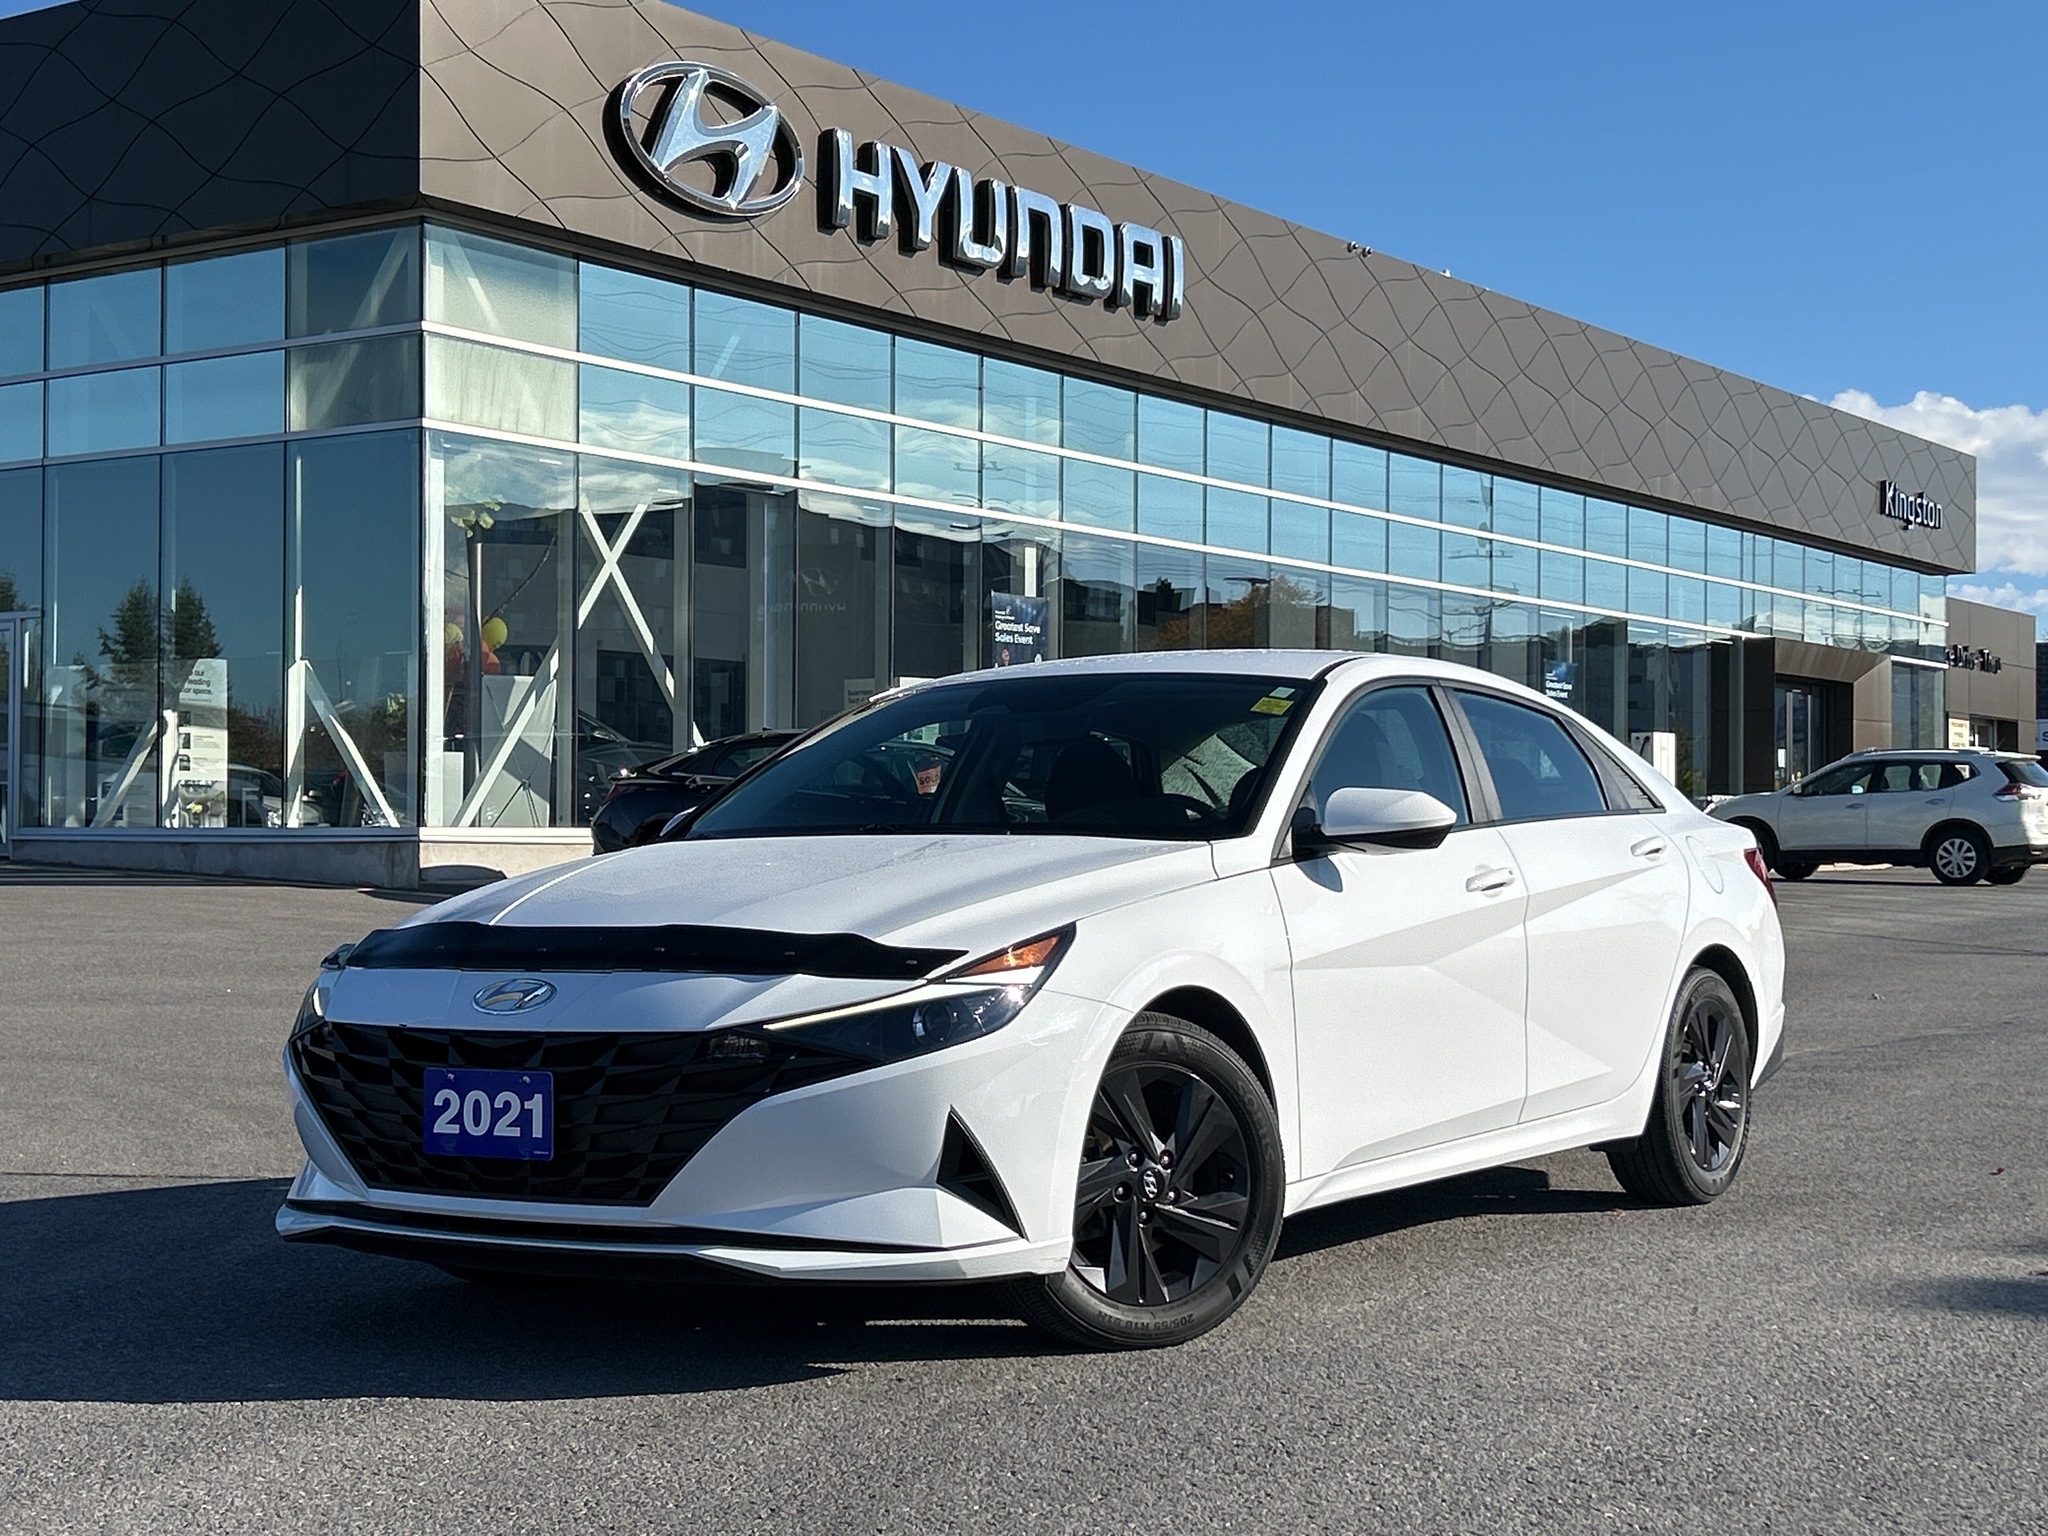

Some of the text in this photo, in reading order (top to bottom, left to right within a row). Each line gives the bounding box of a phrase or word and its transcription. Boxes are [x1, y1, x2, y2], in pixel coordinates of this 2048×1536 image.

[818, 127, 1185, 324] HYUNDAI
[1882, 479, 1943, 530] Kingston
[995, 631, 1034, 645] Sales Event
[1025, 623, 1041, 634] Save
[433, 1088, 543, 1138] 2021
